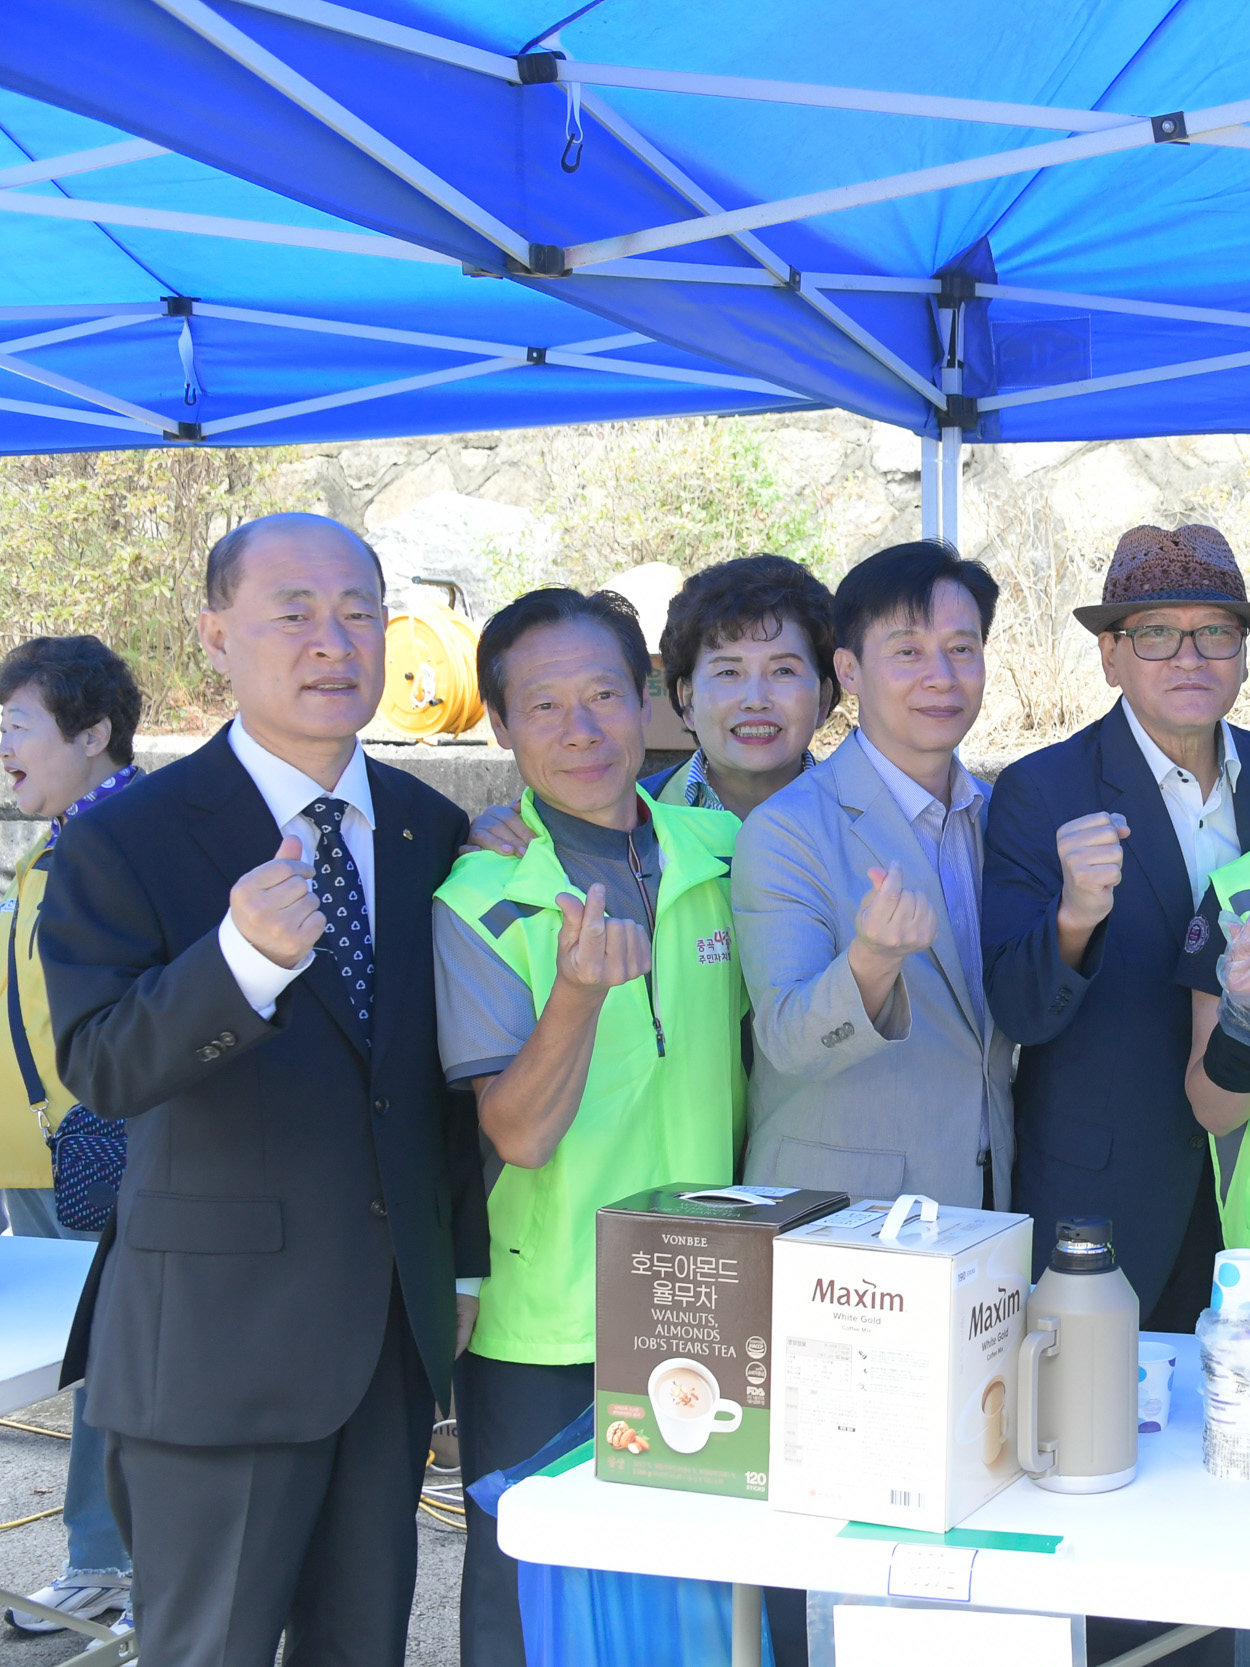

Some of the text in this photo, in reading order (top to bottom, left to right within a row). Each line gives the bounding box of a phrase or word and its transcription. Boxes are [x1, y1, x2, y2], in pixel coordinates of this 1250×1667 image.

[661, 1233, 709, 1248] VONBEE
[631, 1250, 740, 1284] 호두아몬드
[652, 1279, 718, 1310] 율무차
[811, 1277, 904, 1313] Maxim
[651, 1308, 719, 1328] WALNUTS,
[832, 1311, 882, 1325] White Gold
[968, 1285, 1020, 1341] Maxim
[654, 1323, 721, 1342] ALMONDS
[981, 1327, 1009, 1352] White Gold
[633, 1336, 737, 1358] JOB'S TEARS TEA
[744, 1470, 767, 1486] 120
